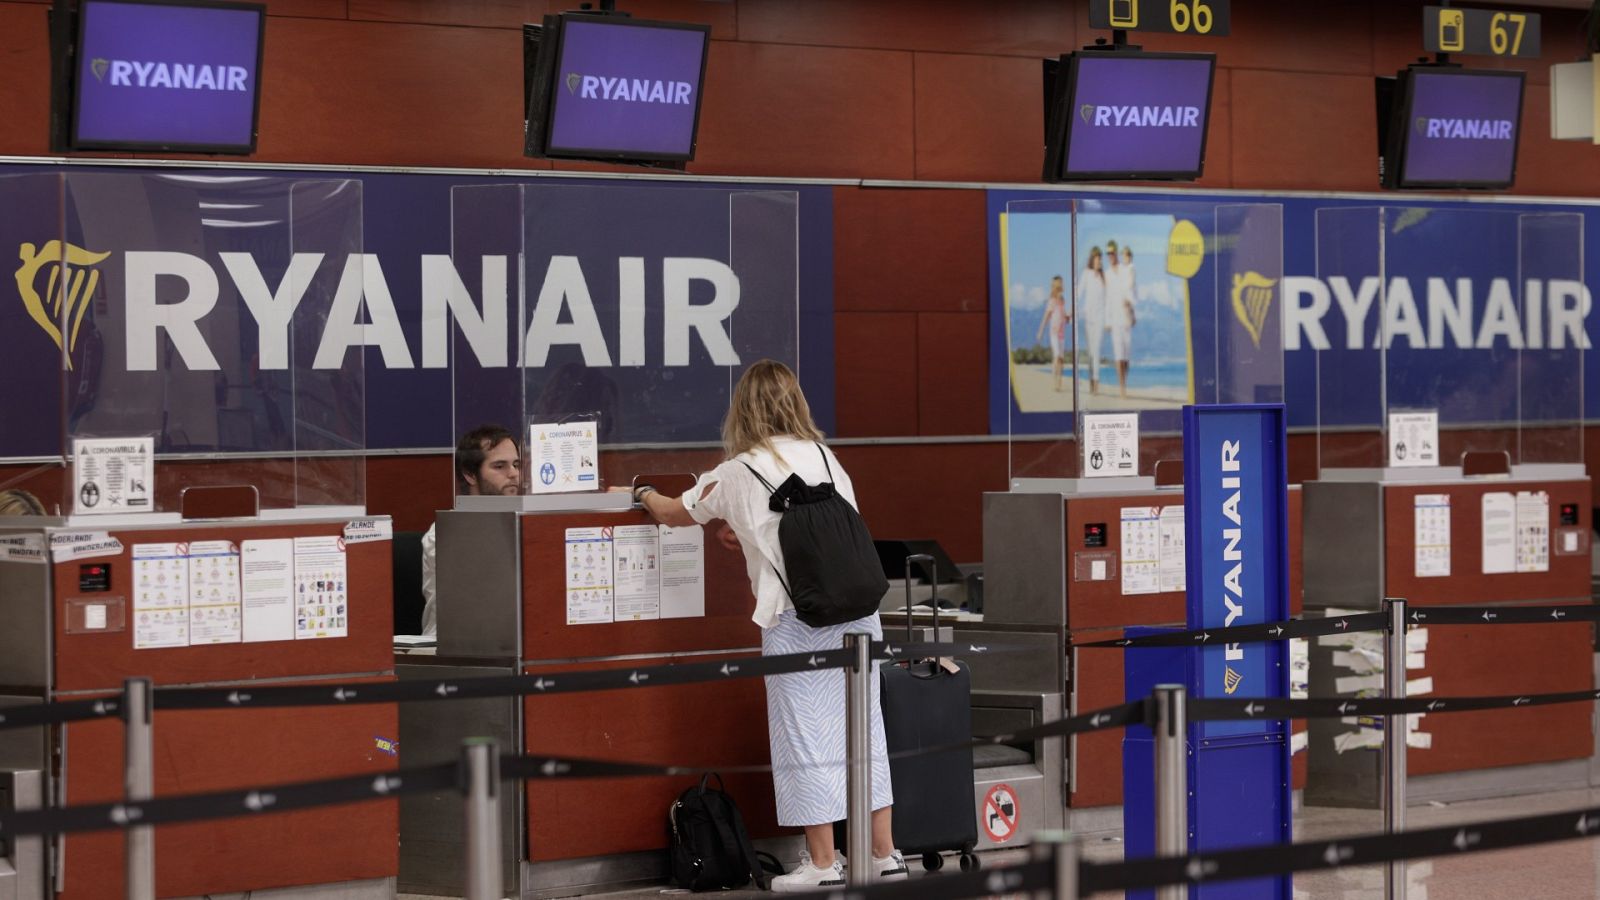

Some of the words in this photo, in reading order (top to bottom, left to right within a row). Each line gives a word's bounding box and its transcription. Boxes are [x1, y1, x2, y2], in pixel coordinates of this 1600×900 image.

[1169, 0, 1213, 34] 66
[1490, 12, 1526, 55] 67
[110, 60, 248, 92] RYANAIR
[581, 75, 692, 105] RYANAIR
[1095, 105, 1200, 127] RYANAIR
[1427, 118, 1512, 140] RYANAIR
[124, 250, 741, 371] RYANAIR
[1283, 276, 1592, 350] RYANAIR
